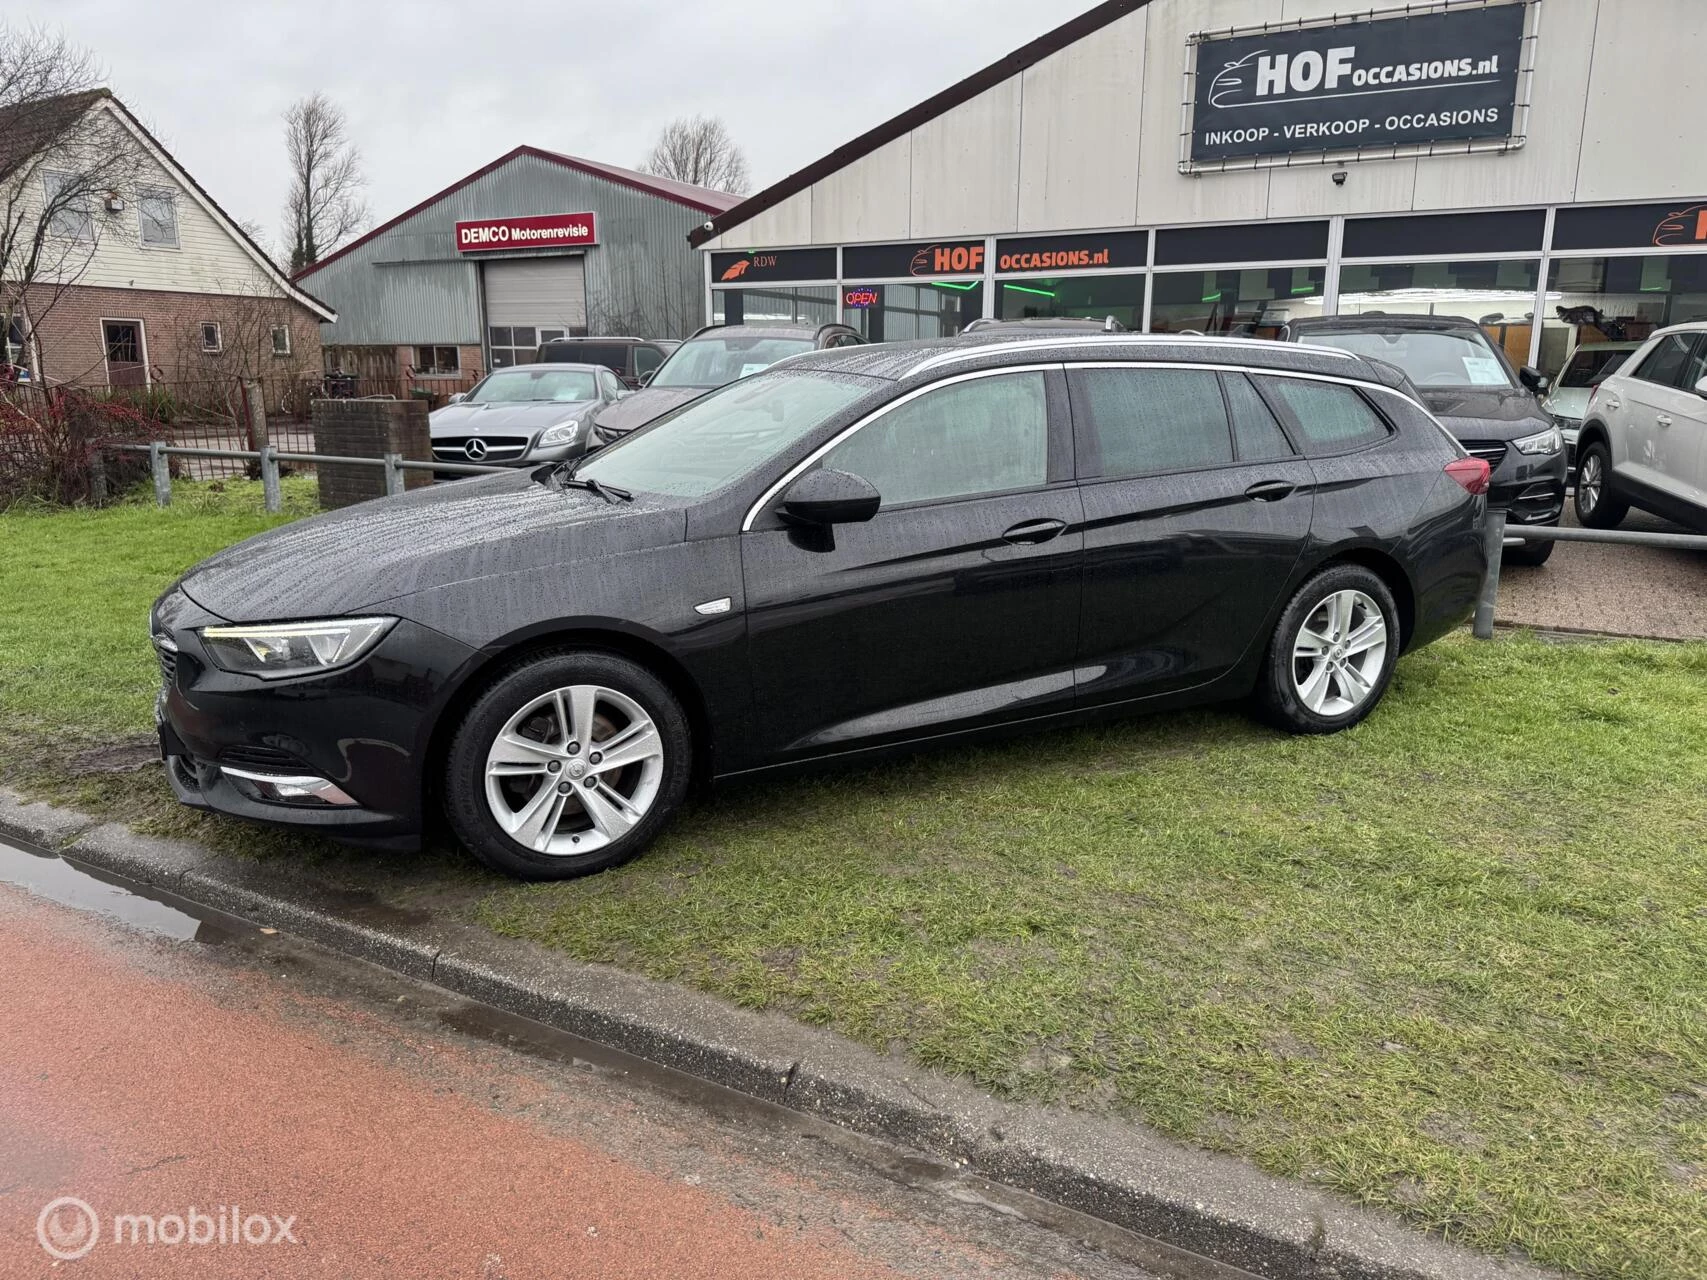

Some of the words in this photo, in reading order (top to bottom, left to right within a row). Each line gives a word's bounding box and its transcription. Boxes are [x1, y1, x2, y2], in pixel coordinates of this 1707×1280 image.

[1255, 46, 1355, 97] HOF
[1205, 127, 1269, 146] INKOOP
[1283, 118, 1370, 140] VERKOOP
[1385, 107, 1499, 131] OCCASIONS
[461, 226, 509, 244] DEMCO
[511, 223, 588, 241] Motorenrevisie
[753, 255, 777, 268] RDW
[934, 246, 984, 271] HOF
[846, 292, 877, 304] OPEN
